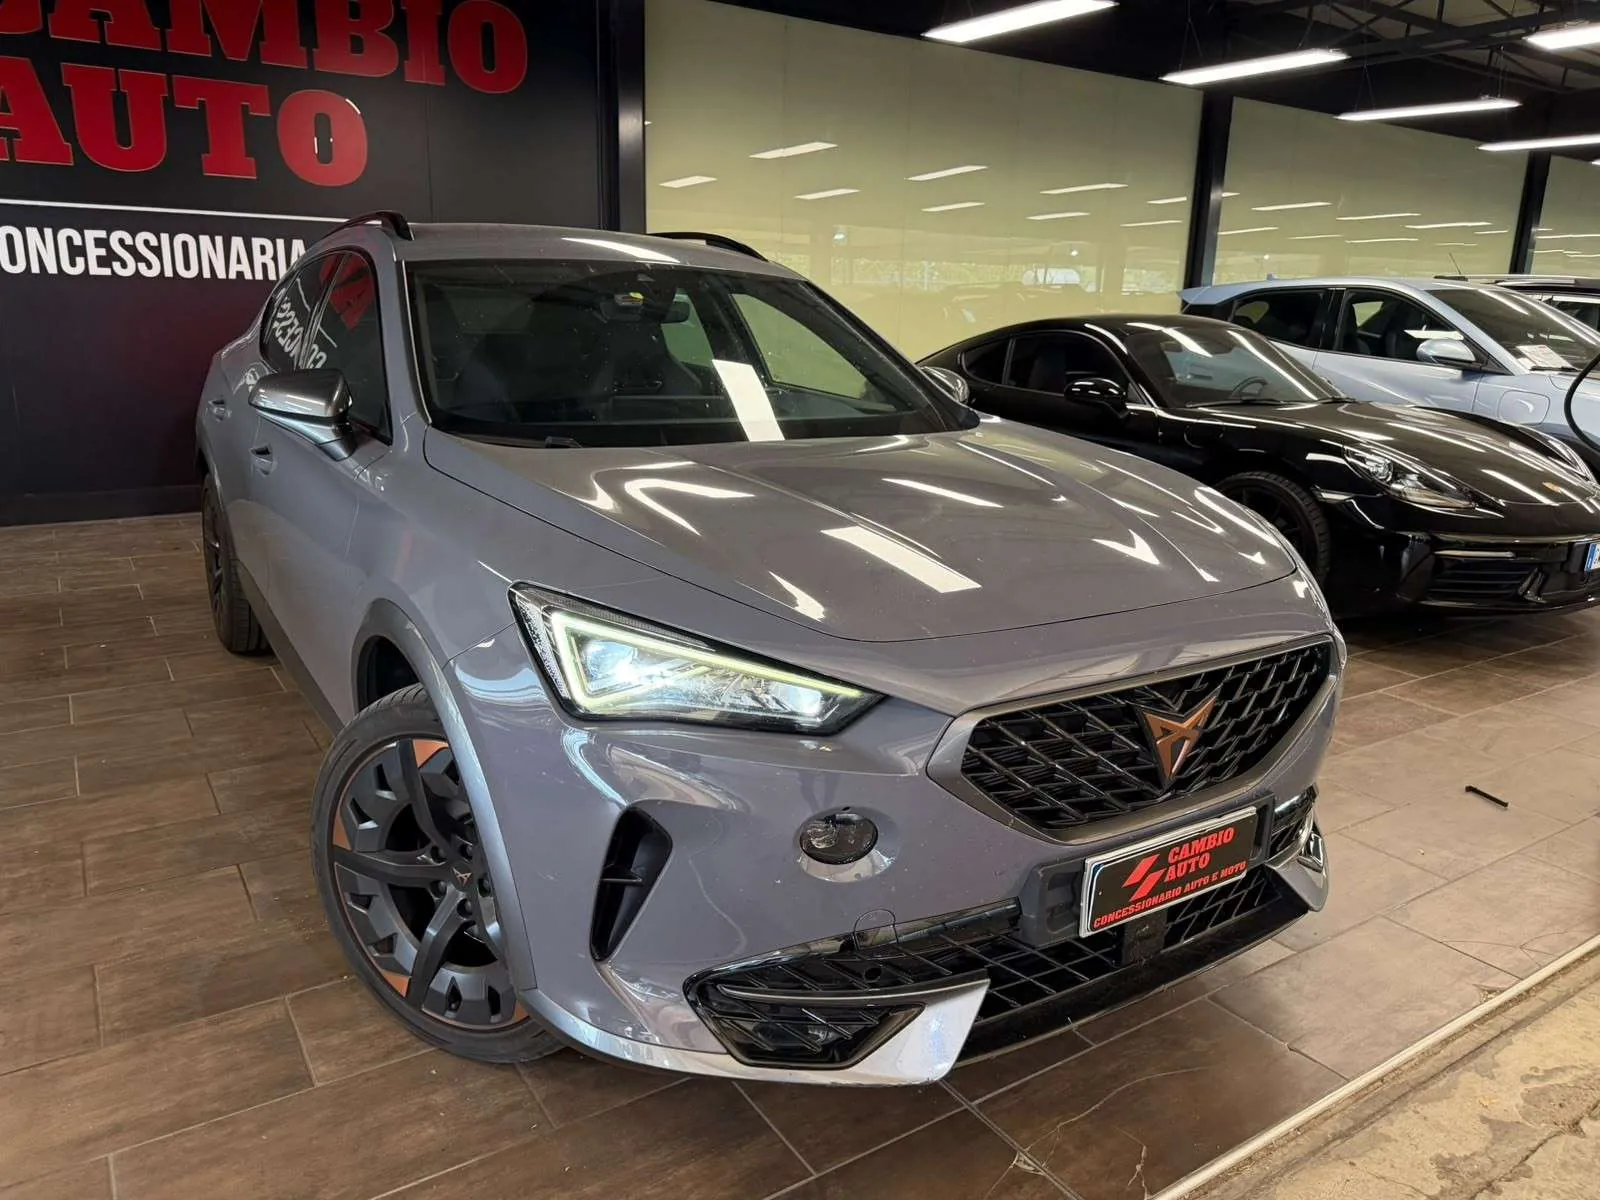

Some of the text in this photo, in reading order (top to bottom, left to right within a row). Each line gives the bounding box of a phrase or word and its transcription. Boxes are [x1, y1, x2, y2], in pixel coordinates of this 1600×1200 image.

[0, 0, 528, 94] AMBIO
[0, 56, 368, 187] AUTO
[1164, 852, 1212, 882] AUTO
[1167, 827, 1236, 864] CAMBIO
[1093, 860, 1247, 929] CONCESSIONARIO AUTO E MOTO
